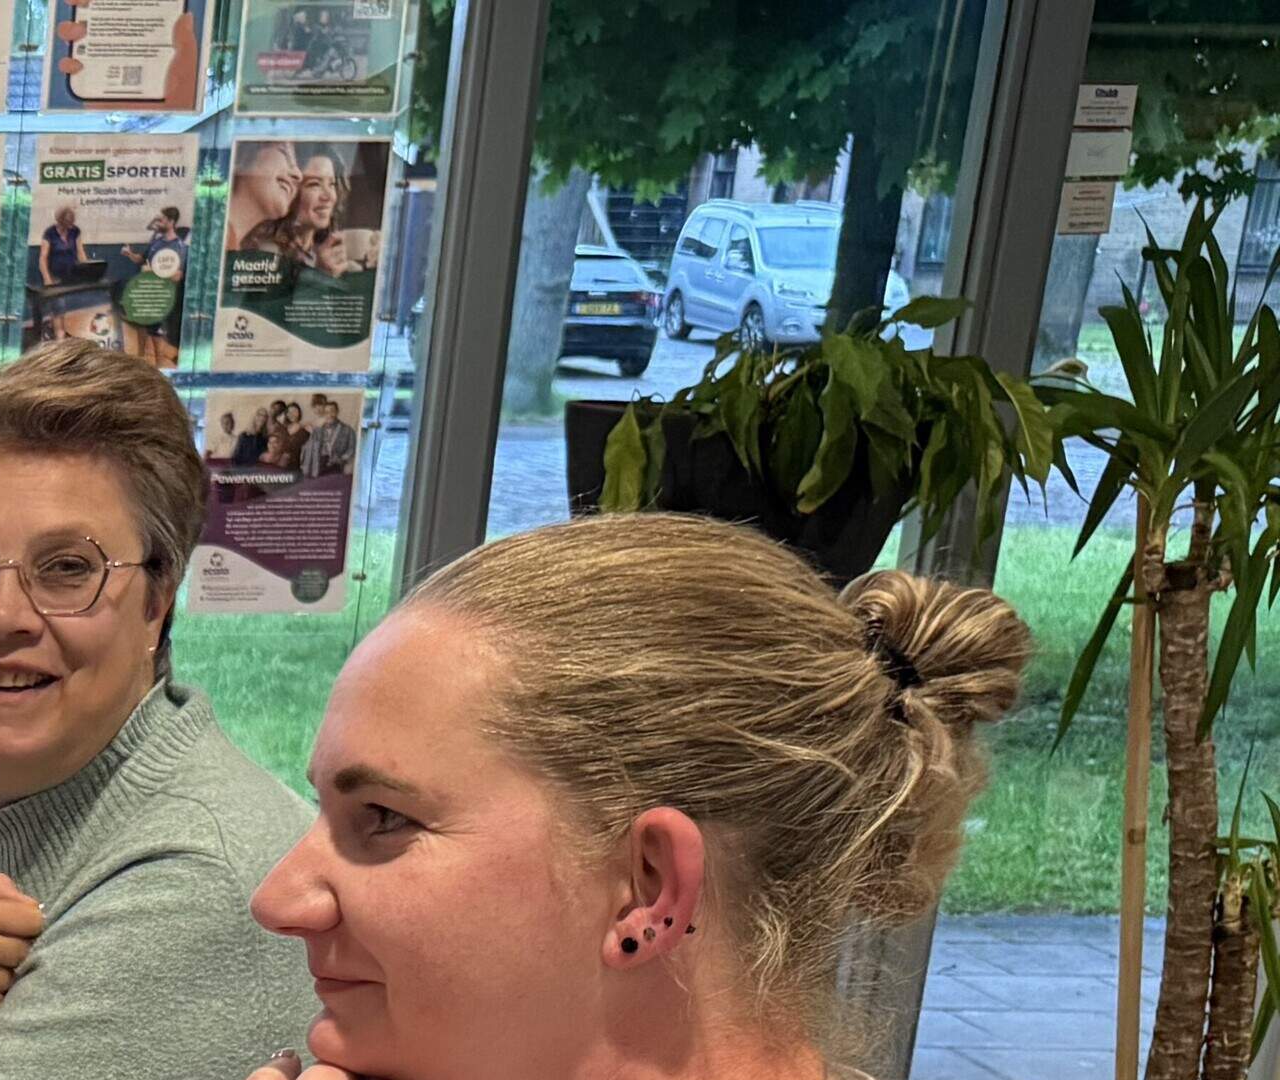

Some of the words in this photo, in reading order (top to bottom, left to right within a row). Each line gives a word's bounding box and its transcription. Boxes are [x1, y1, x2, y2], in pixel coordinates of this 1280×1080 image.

[43, 166, 101, 178] GRATIS
[107, 166, 185, 178] SPORTEN!
[233, 256, 278, 273] Maatje
[231, 274, 282, 287] gezocht
